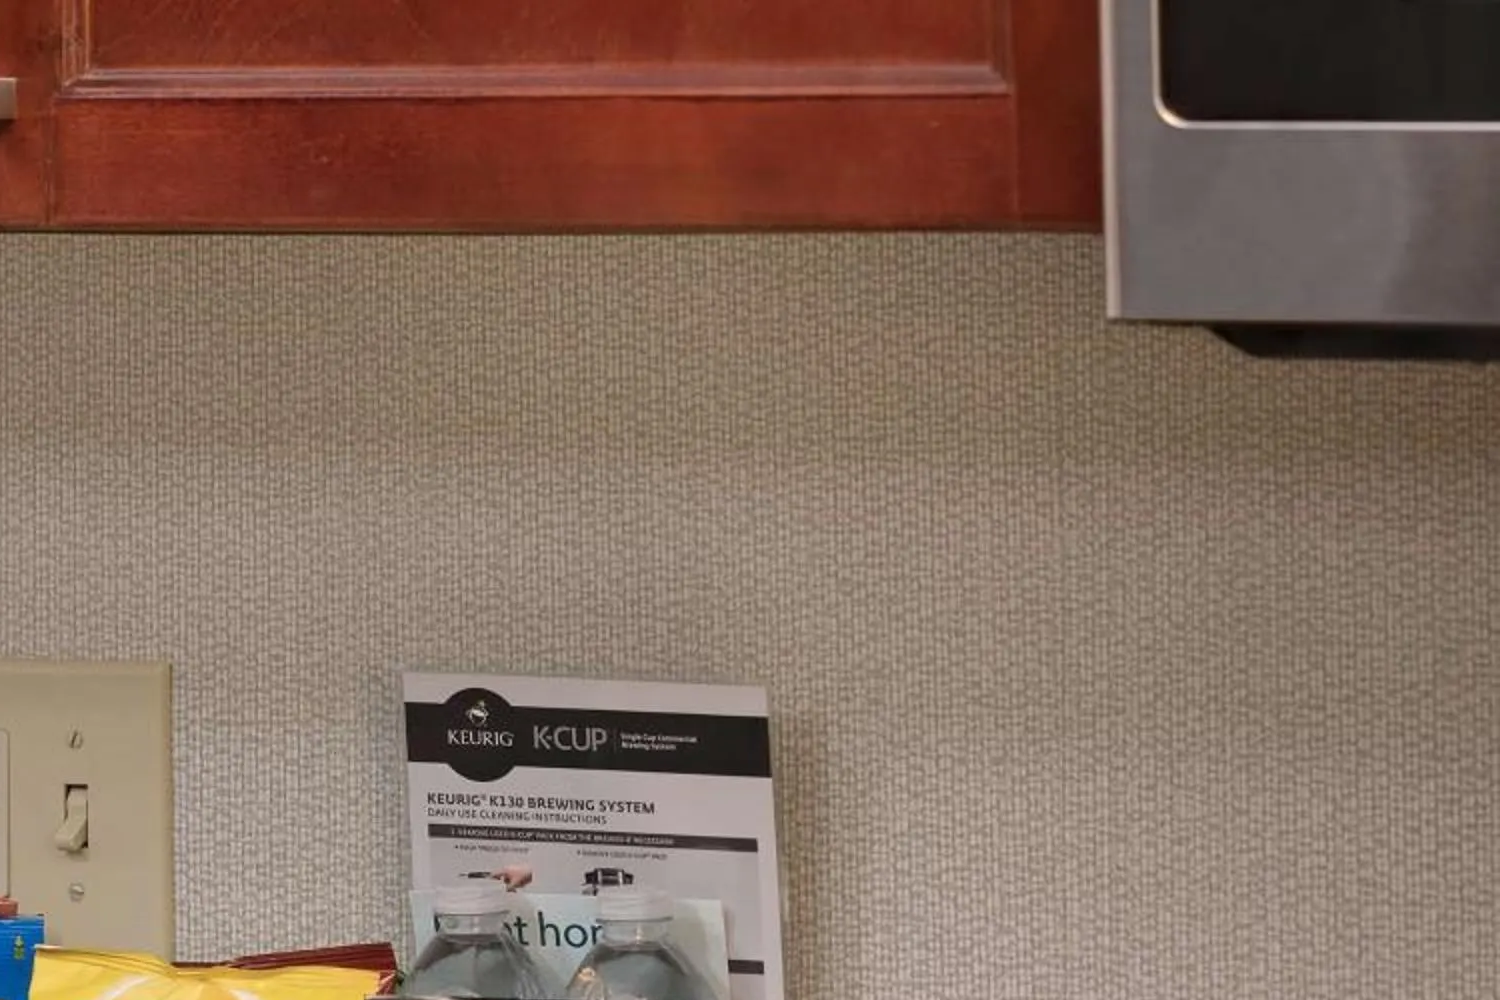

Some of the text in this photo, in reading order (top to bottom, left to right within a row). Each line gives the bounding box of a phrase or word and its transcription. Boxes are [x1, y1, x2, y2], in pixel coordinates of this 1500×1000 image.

[447, 729, 514, 747] KEURIG
[427, 807, 457, 819] DAILY
[457, 808, 478, 819] USE
[479, 809, 530, 822] CLEANING
[489, 796, 523, 808] K130
[527, 797, 595, 812] BREWING
[599, 800, 656, 815] SYSTEM
